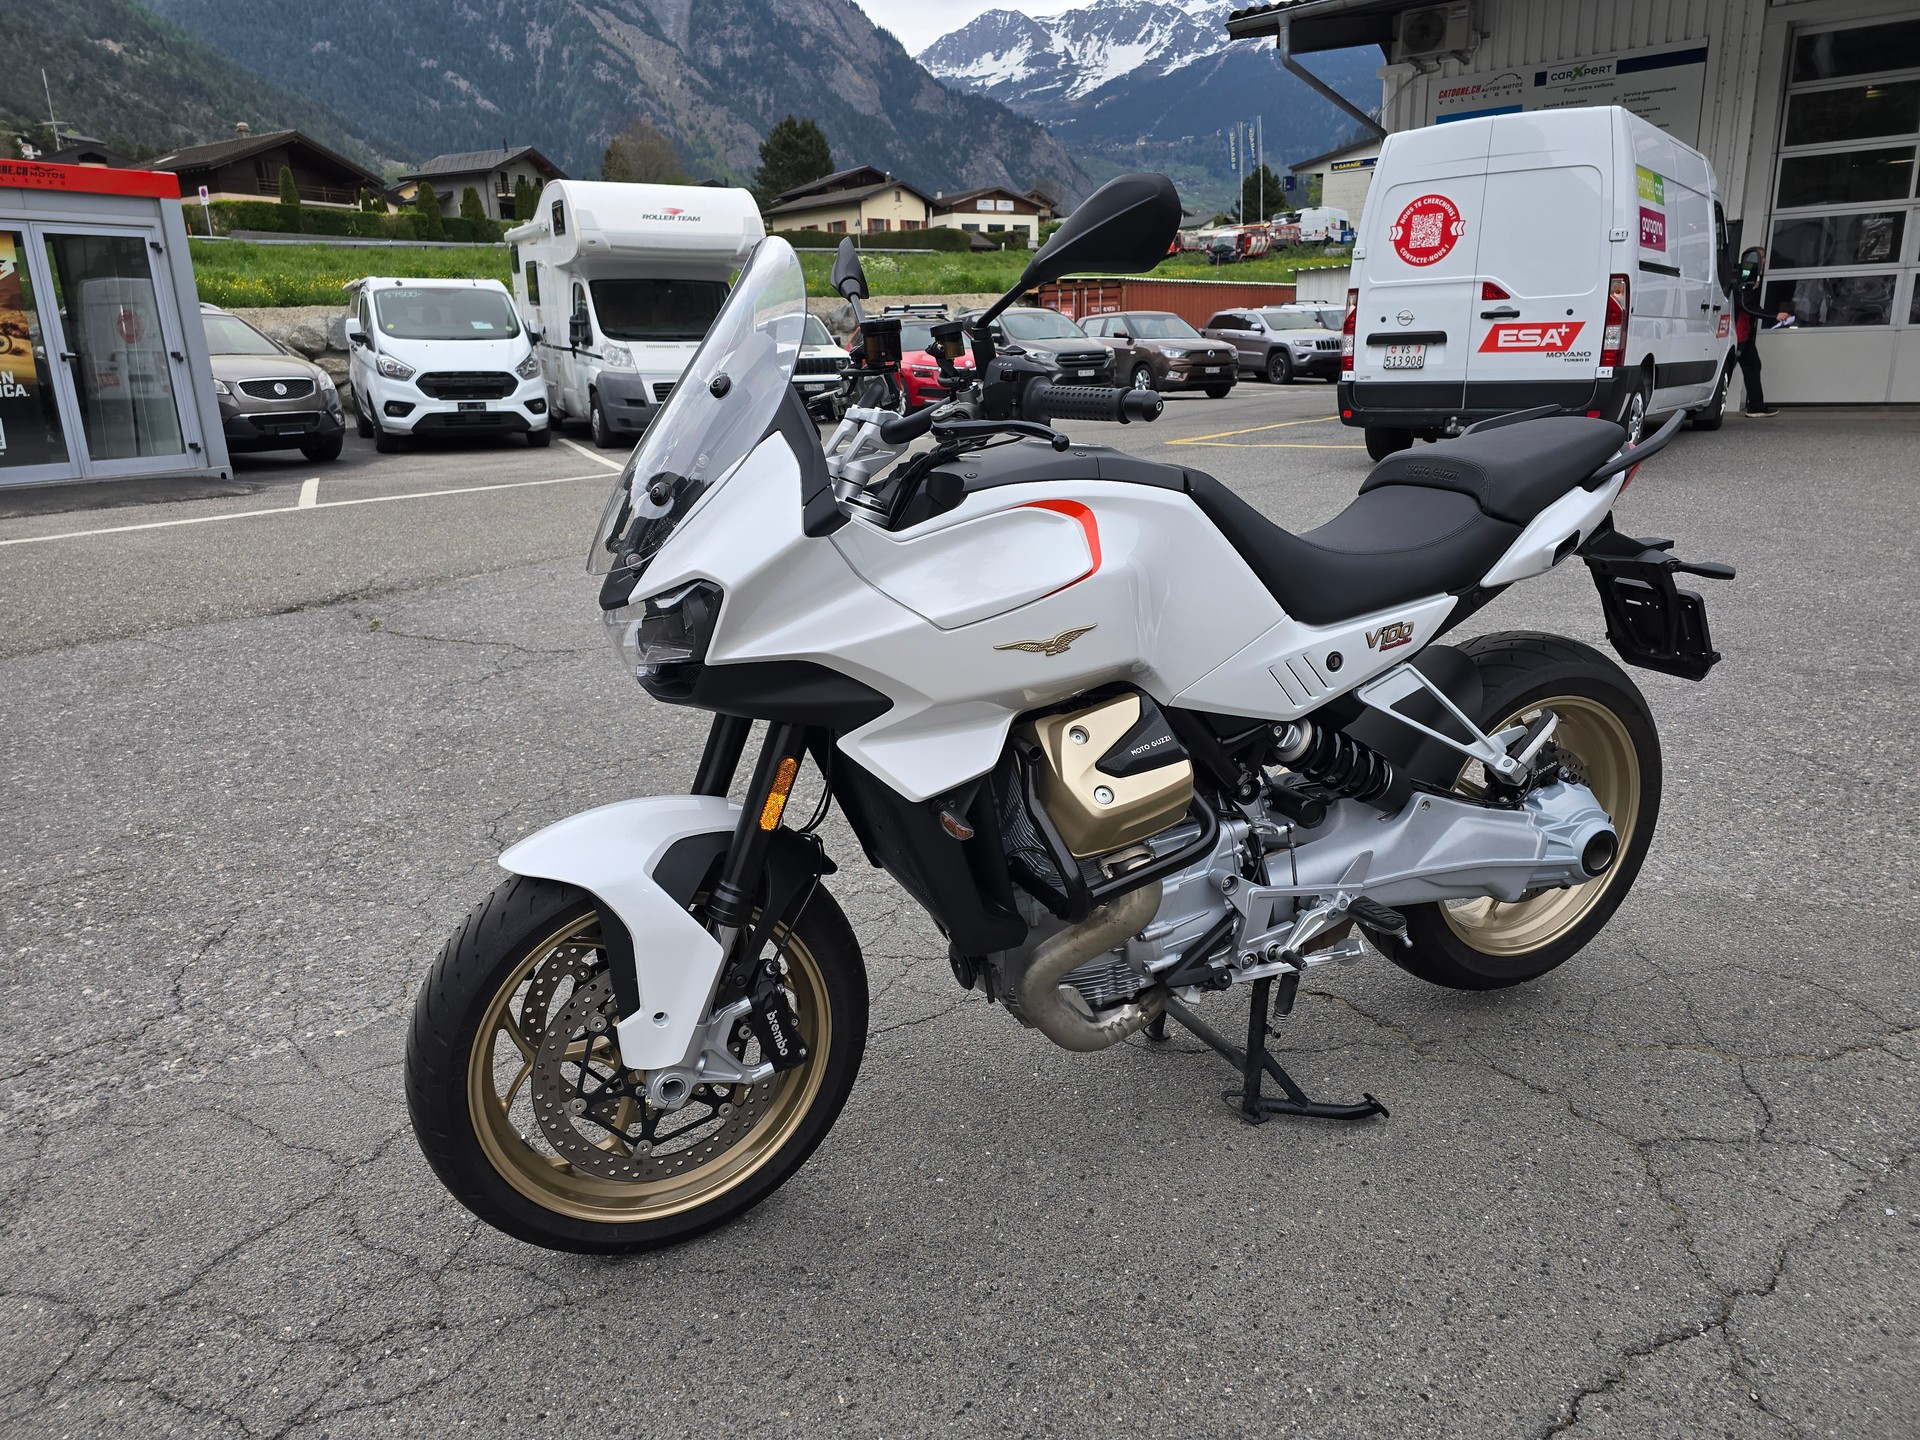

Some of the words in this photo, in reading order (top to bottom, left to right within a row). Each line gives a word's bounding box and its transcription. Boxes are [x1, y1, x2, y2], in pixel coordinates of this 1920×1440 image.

[1439, 85, 1482, 99] CATOGNE.CH
[1481, 82, 1523, 93] AUTOS-MOTOS
[1439, 89, 1522, 105] VOLLEGES
[30, 171, 66, 179] MOTOS
[1400, 206, 1415, 224] NOUS
[1414, 200, 1423, 209] TE
[1401, 345, 1411, 354] VS
[1546, 351, 1592, 359] MOVANO
[1365, 621, 1414, 649] V100
[1130, 744, 1151, 756] MOTO
[1151, 734, 1172, 747] GUZZI
[766, 1009, 789, 1057] brembo
